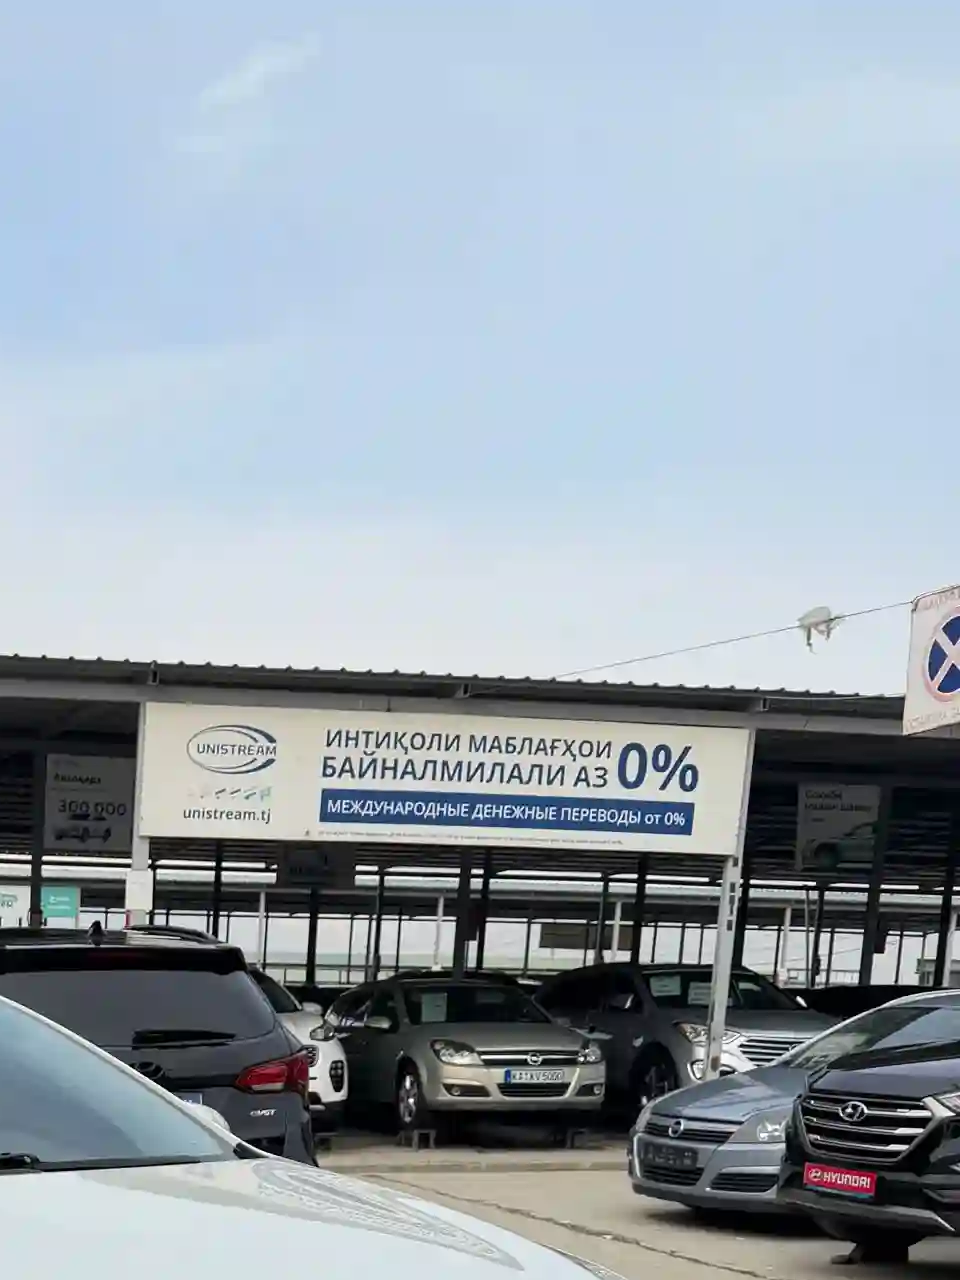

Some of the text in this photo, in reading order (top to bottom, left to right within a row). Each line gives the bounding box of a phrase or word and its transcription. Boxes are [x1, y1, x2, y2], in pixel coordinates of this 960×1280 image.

[197, 743, 277, 756] UNISTREAM
[325, 729, 613, 762] ИНТИҚОЛИ МАБЛАҒҲОИ
[322, 750, 609, 789] БАЙНАЛМИЛАЛИ АЗ
[617, 742, 699, 792] 0%
[183, 808, 271, 824] unistream.tj
[327, 799, 686, 827] МЕЖДУНАРОДНЫЕ ДЕНЕЖНЫЕ ПЕРЕВОДЫ от 0%
[823, 1171, 871, 1189] HYUNDAI
